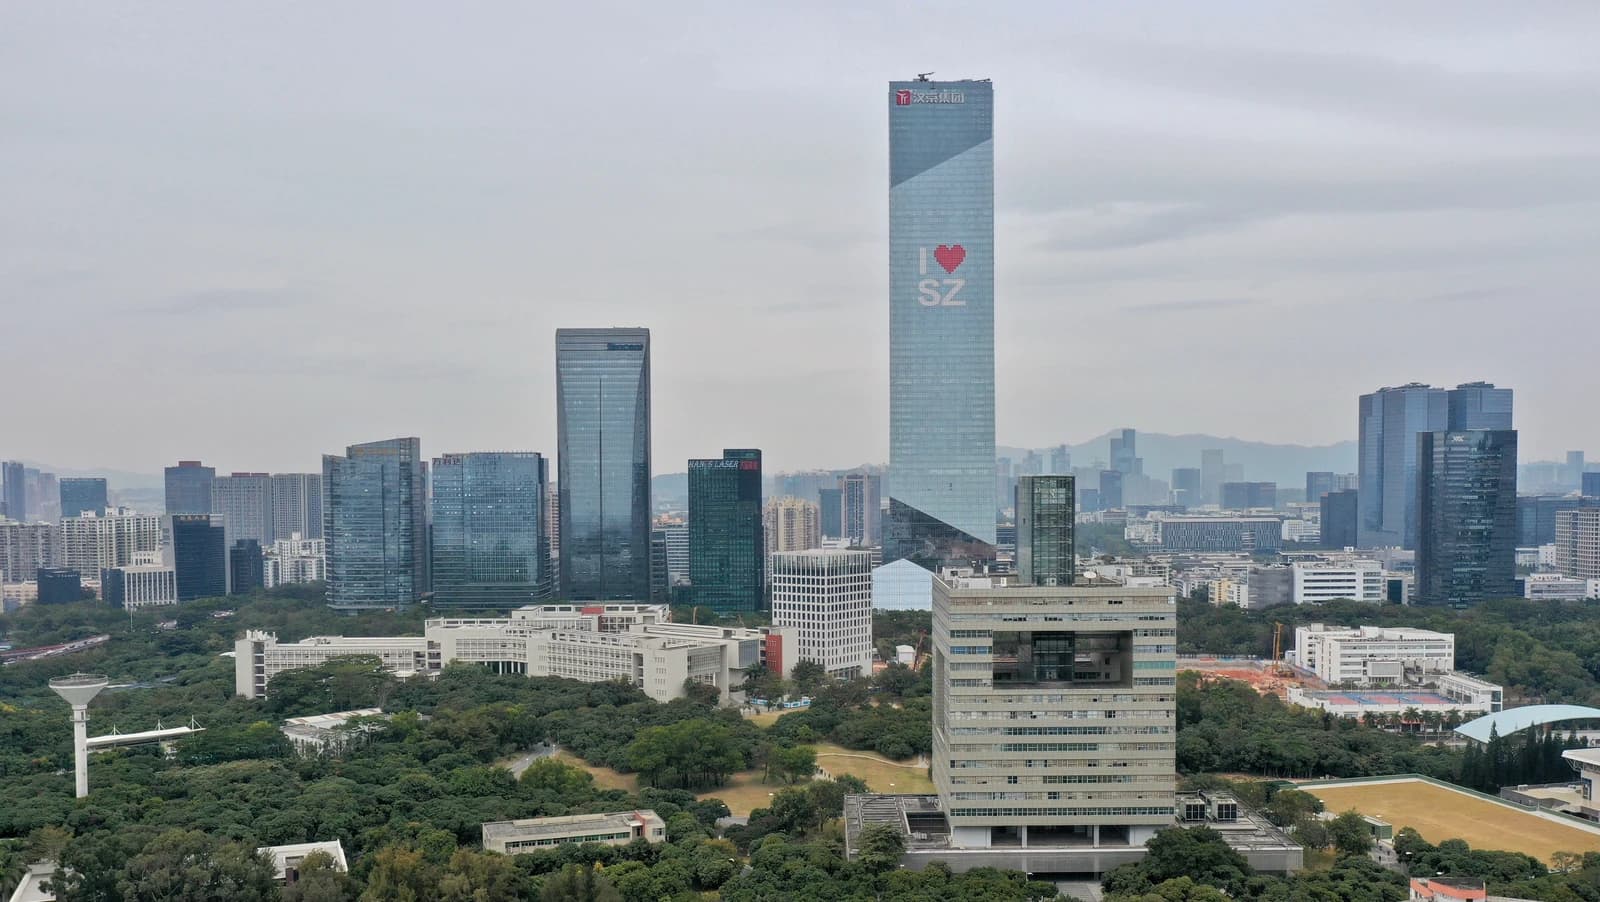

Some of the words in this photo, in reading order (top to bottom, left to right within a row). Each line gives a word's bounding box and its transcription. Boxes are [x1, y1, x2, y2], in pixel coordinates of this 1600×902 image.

[913, 92, 964, 103] 汉京集团
[919, 247, 927, 275] I
[918, 279, 966, 306] SZ
[688, 460, 713, 469] HANS
[714, 460, 739, 469] LASER
